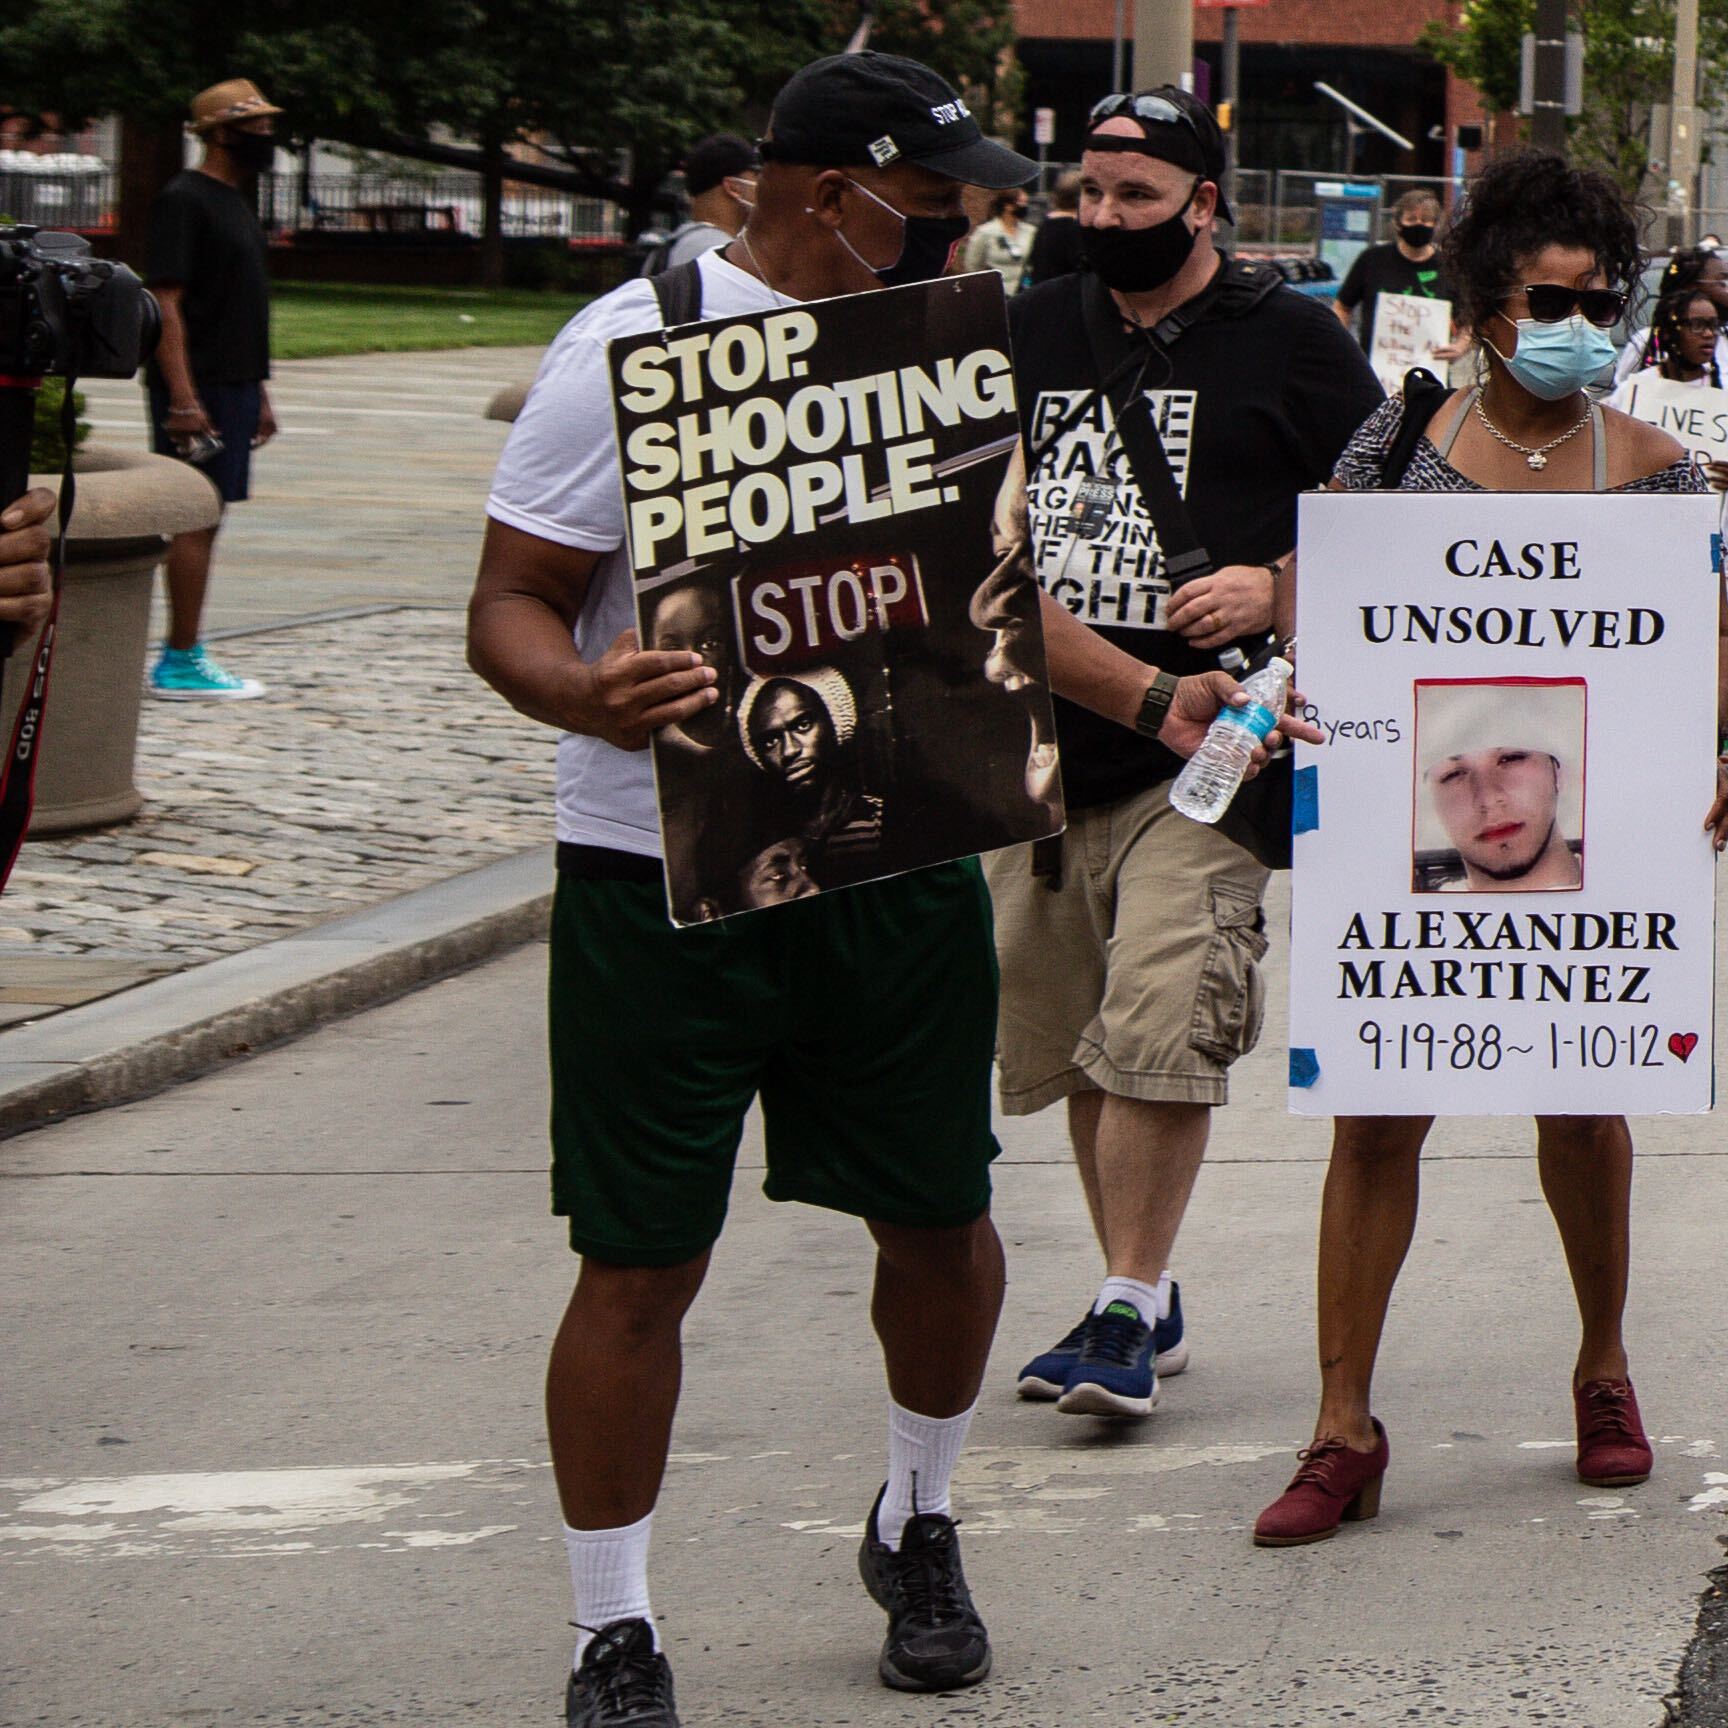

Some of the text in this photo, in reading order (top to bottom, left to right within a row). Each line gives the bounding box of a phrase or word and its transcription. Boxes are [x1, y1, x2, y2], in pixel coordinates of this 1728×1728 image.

[931, 103, 960, 125] STOP
[621, 311, 818, 413] STOP.
[626, 349, 1016, 490] SHOOTING
[631, 439, 960, 569] PEOPLE.
[1445, 539, 1582, 580] CASE
[751, 564, 907, 655] STOP
[1359, 605, 1666, 649] UNSOLVED
[1323, 718, 1401, 747] years
[1338, 910, 1679, 952] ALEXANDER
[1337, 960, 1652, 1004] MARTINEZ
[1358, 1021, 1667, 1072] 9-19-88 1-10-12
